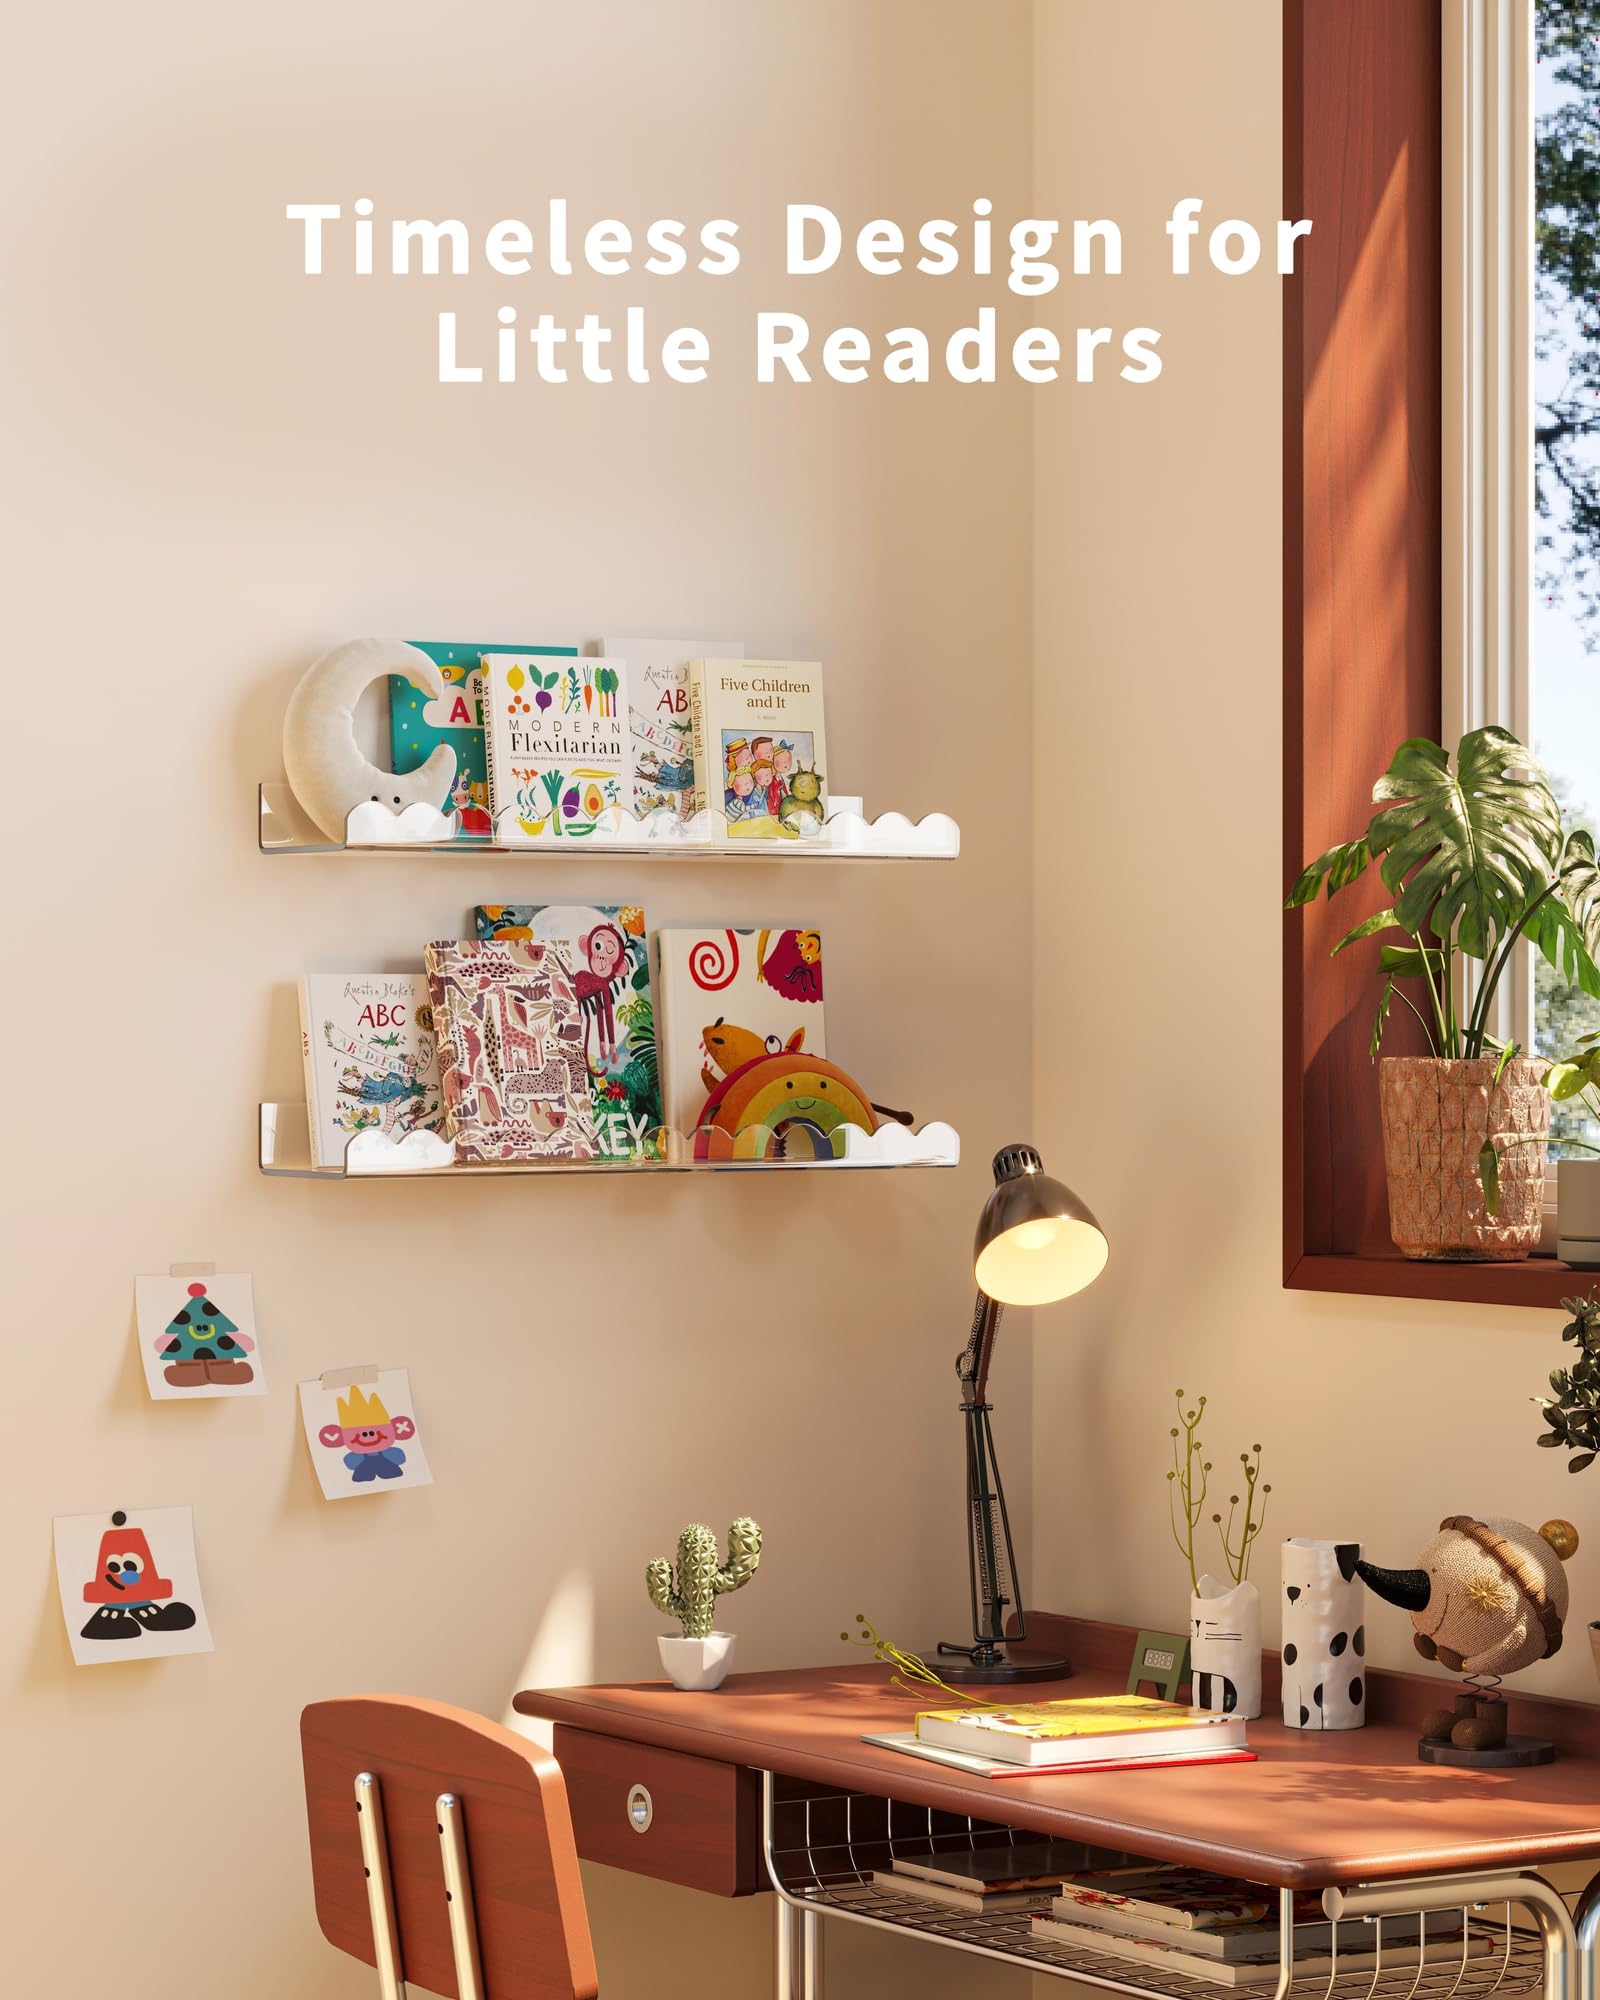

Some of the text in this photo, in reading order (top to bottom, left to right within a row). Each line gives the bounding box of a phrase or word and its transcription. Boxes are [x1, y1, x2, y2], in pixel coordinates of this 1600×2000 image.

[720, 677, 811, 693] Five Children
[656, 688, 692, 714] AB
[746, 695, 787, 709] and It
[483, 686, 493, 749] MODERN
[508, 719, 621, 734] MODERN
[692, 682, 704, 758] Five Children and It
[511, 732, 622, 755] Flexitarian
[357, 1003, 406, 1028] ABC
